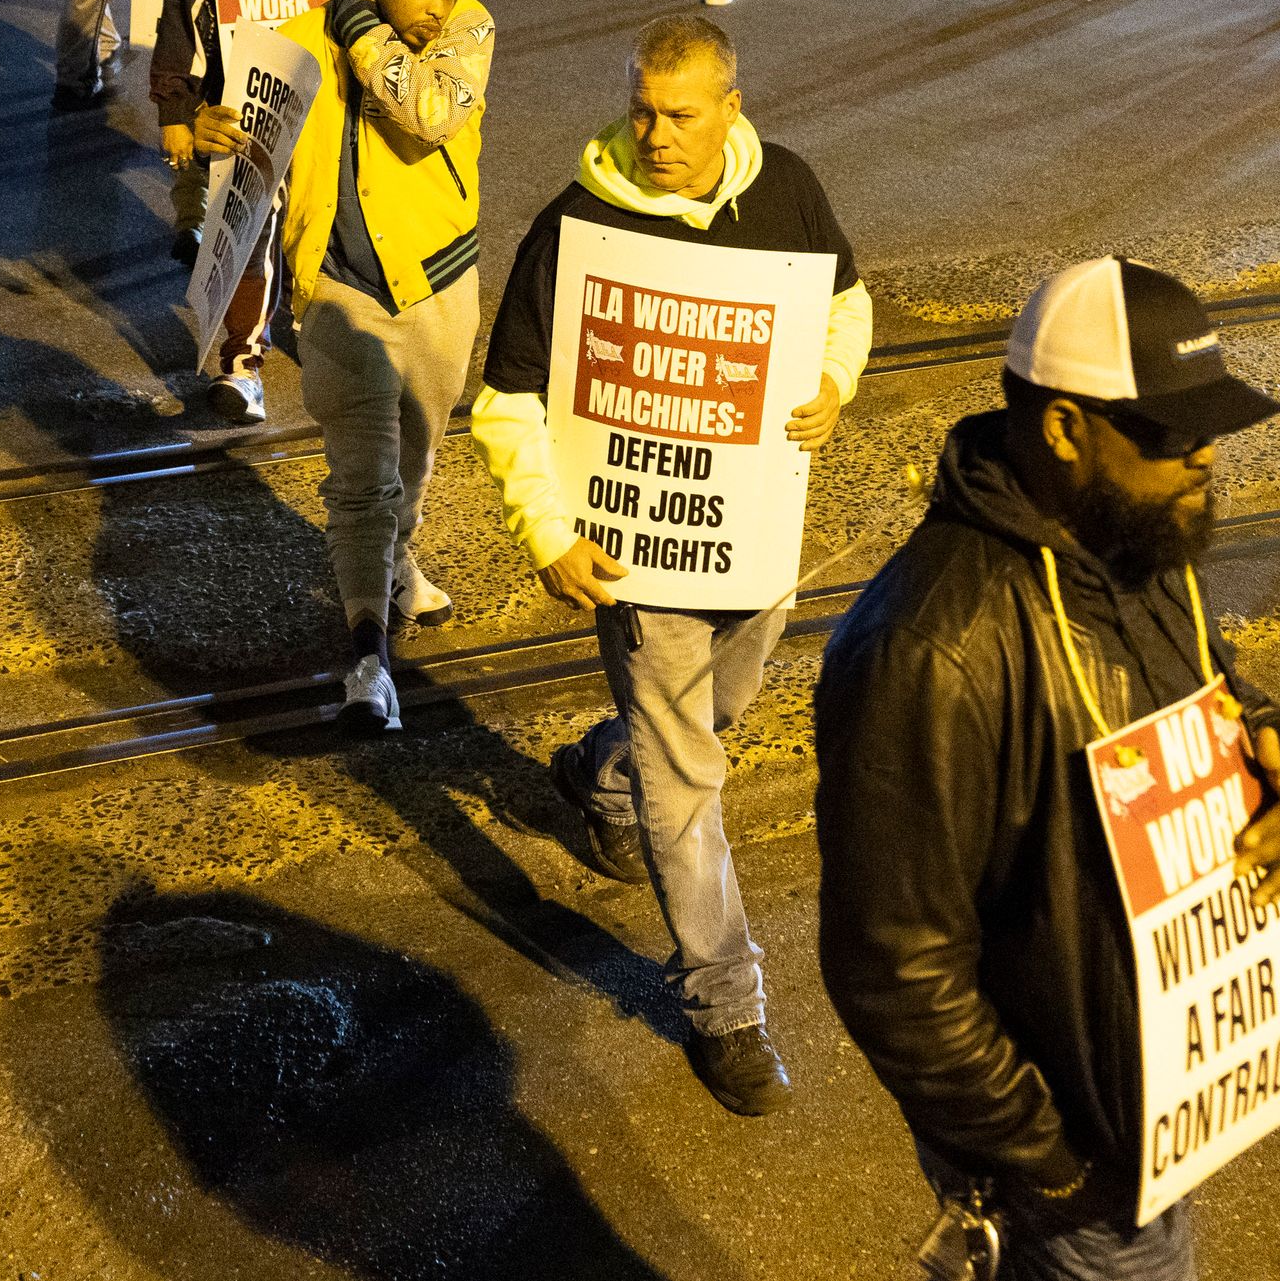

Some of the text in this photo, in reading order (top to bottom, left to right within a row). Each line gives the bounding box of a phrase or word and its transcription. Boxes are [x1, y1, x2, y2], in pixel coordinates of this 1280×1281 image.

[240, 102, 282, 155] GREED
[584, 280, 772, 344] ILA WORKERS
[632, 341, 707, 388] OVER
[588, 378, 744, 438] MACHINES:
[607, 432, 712, 481] DEFEND
[587, 475, 725, 528] OUR JOBS
[573, 517, 733, 574] AND RIGHTS
[1154, 703, 1214, 794] NO
[1145, 772, 1249, 896] WORK
[1186, 958, 1277, 1072] A FAIR
